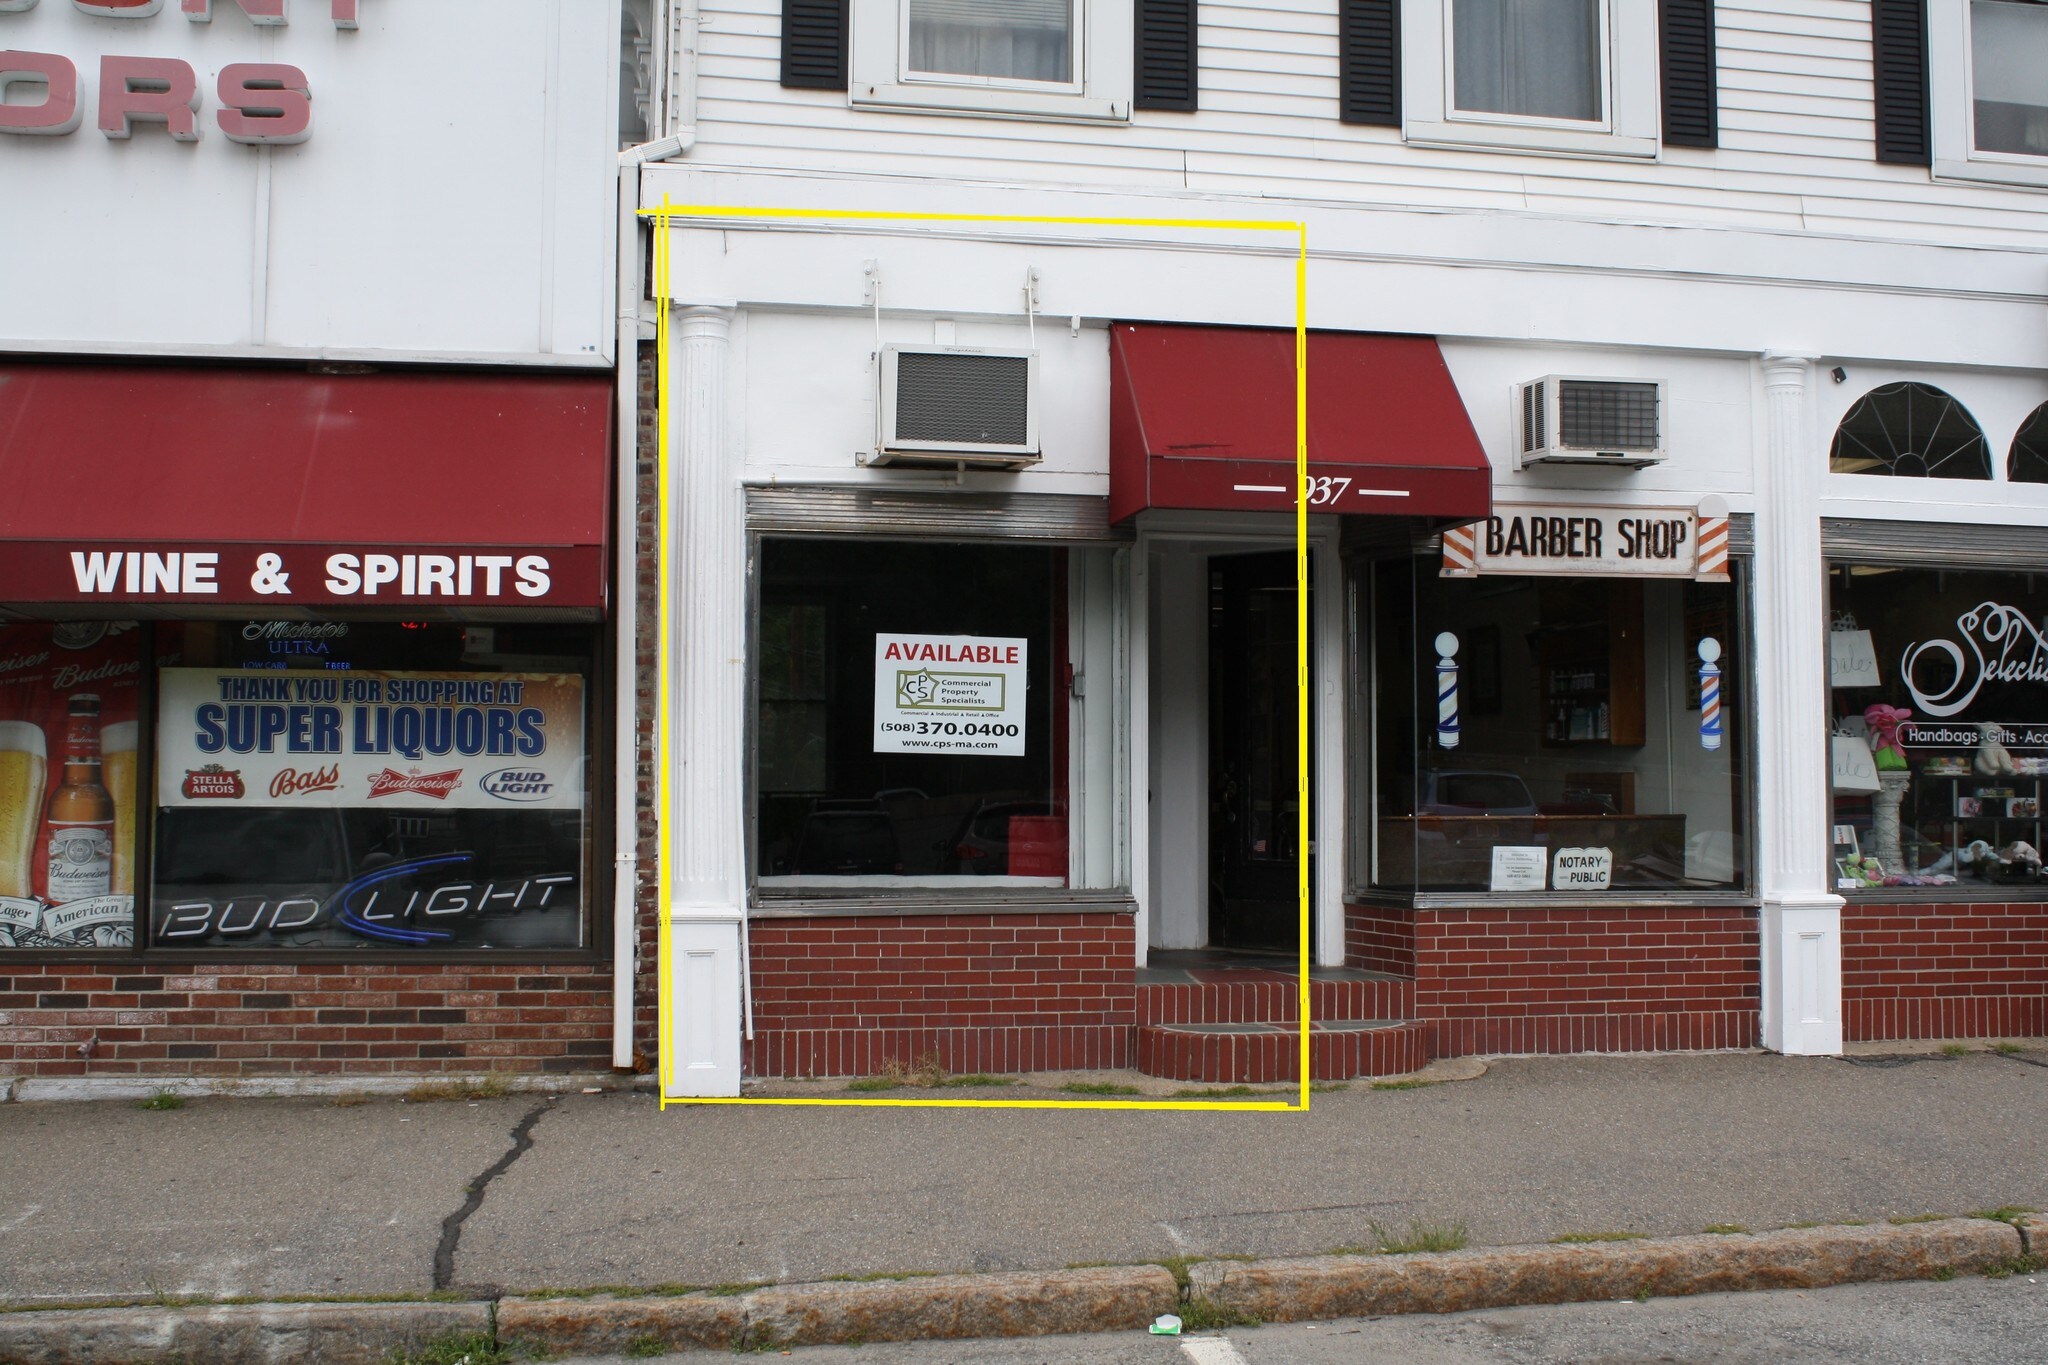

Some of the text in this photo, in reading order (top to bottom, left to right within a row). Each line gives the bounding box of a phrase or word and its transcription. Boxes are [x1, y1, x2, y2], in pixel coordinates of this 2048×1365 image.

[1485, 515, 1687, 560] BARBER SHOP
[70, 551, 551, 597] WINE & SPIRITS
[242, 620, 350, 641] Michelob
[268, 640, 330, 654] ULTRA
[884, 642, 1019, 665] AVAILABLE
[331, 662, 351, 670] BEER
[218, 676, 525, 705] THANK YOU FOR SHOPPING AT
[941, 679, 992, 688] Commercial
[941, 688, 979, 697] Property
[941, 696, 986, 705] Specialists
[194, 702, 547, 760] SUPER LIQUORS
[1908, 729, 1978, 745] Handbags
[1986, 729, 2017, 744] Gifts
[901, 739, 998, 749] www.cps-ma.com
[192, 775, 235, 786] STELLA
[268, 762, 340, 798] Bass
[367, 772, 463, 791] Budweiser
[498, 772, 547, 783] BUD
[191, 784, 235, 794] ARTOIS
[489, 783, 554, 794] LIGHT
[1559, 856, 1603, 868] NOTARY
[49, 862, 109, 879] Budweiser
[1570, 871, 1607, 883] PUBLIC
[158, 875, 574, 938] BUD LIGHT
[53, 903, 119, 928] American
